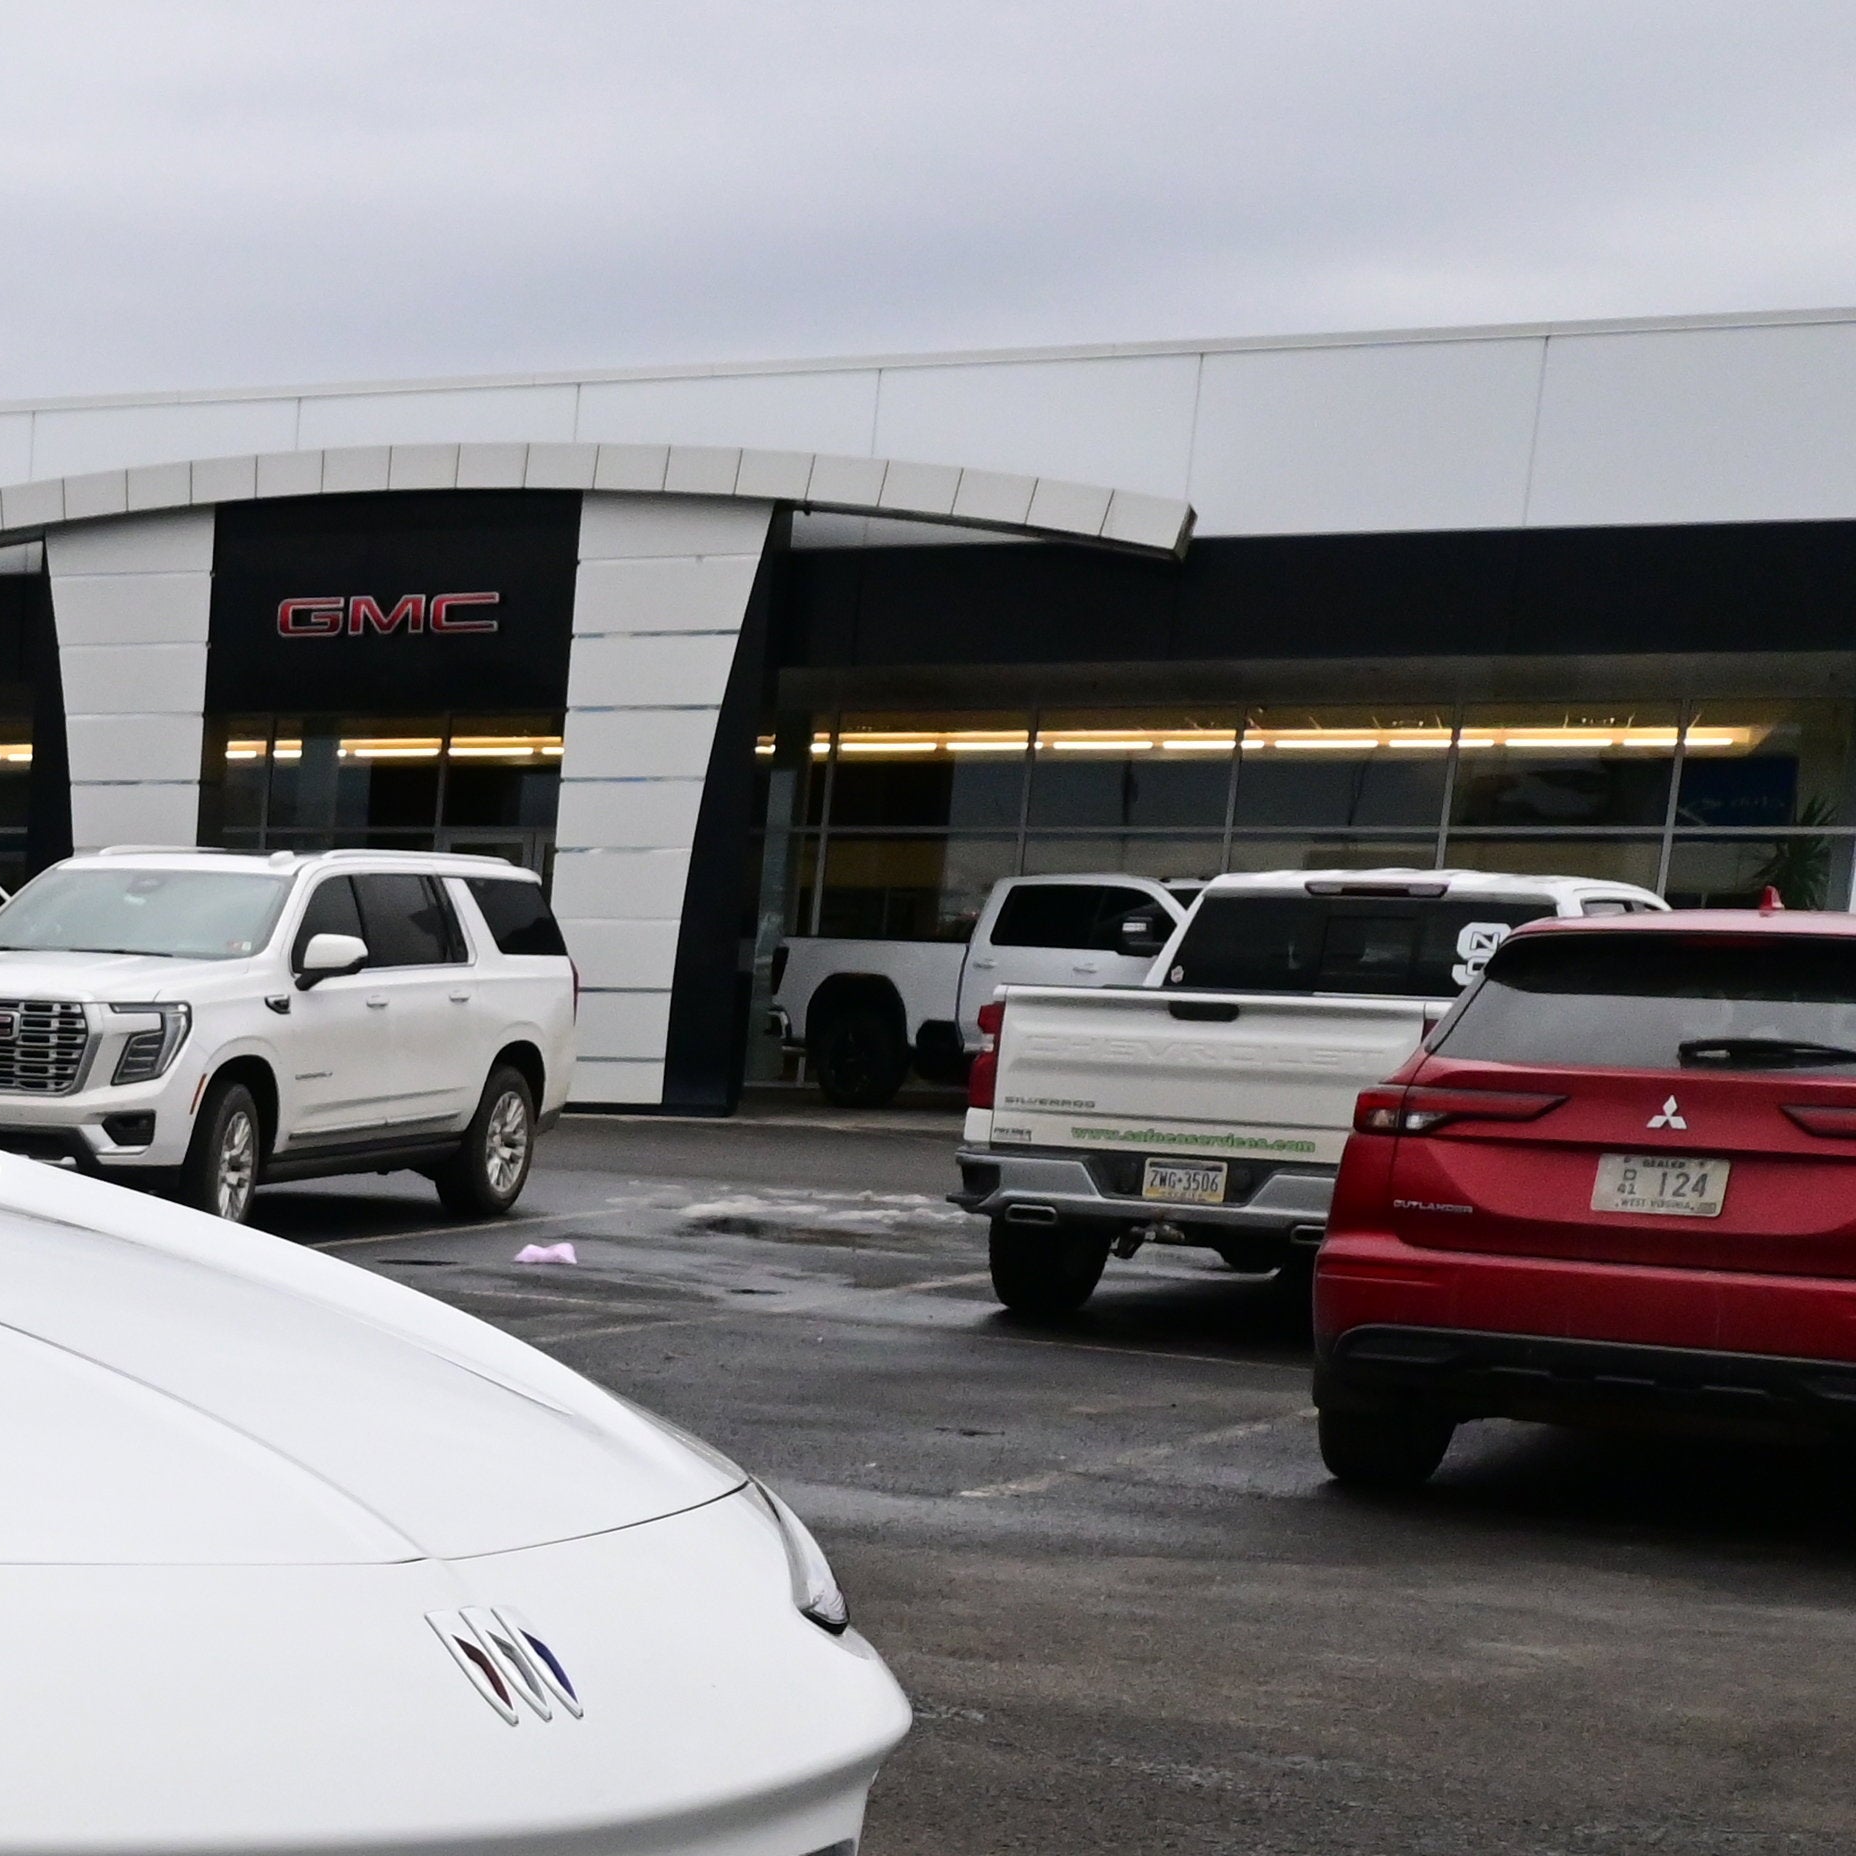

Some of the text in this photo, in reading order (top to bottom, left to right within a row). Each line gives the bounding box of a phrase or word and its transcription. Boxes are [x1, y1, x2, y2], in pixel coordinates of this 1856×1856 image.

[278, 592, 499, 637] GMC
[1659, 1171, 1708, 1198] 124
[1393, 1199, 1473, 1213] OUTLANDER
